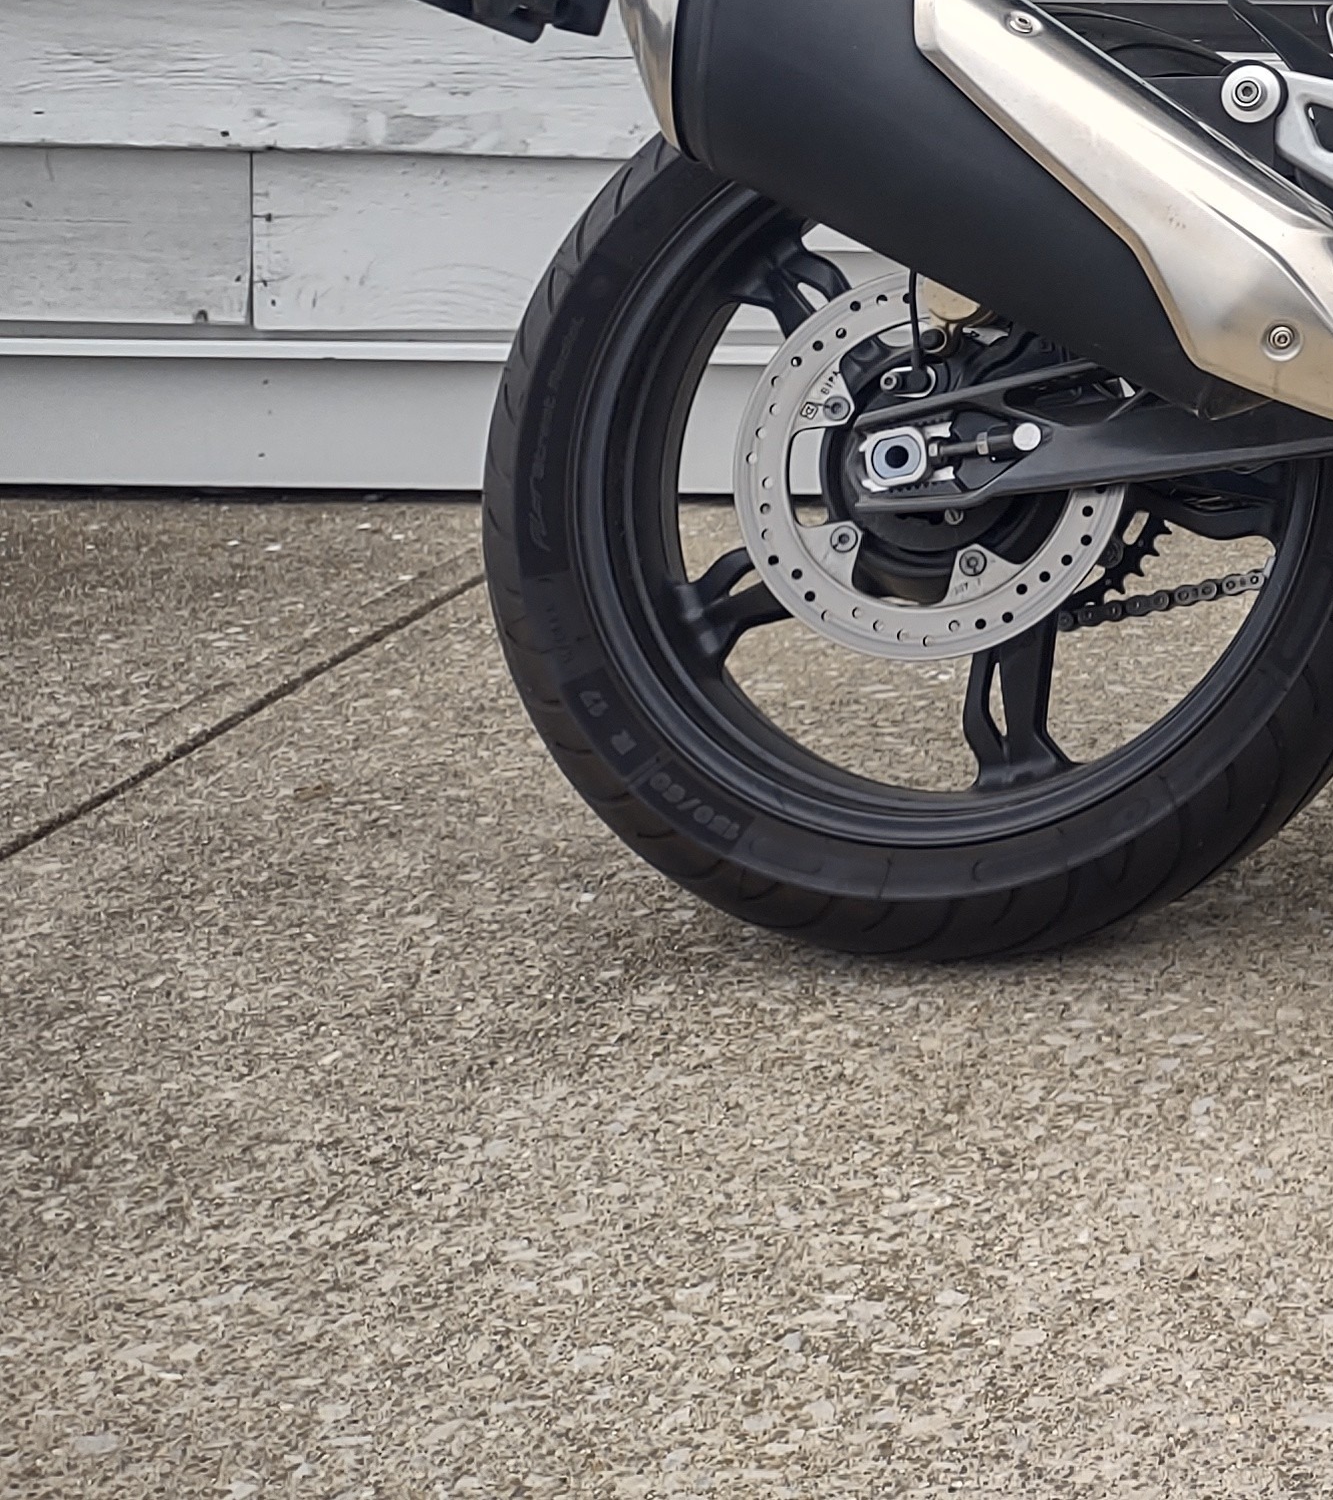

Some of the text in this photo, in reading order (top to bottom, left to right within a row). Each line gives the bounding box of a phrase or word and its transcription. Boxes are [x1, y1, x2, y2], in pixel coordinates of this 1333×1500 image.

[578, 690, 741, 841] 150/60 R 17
